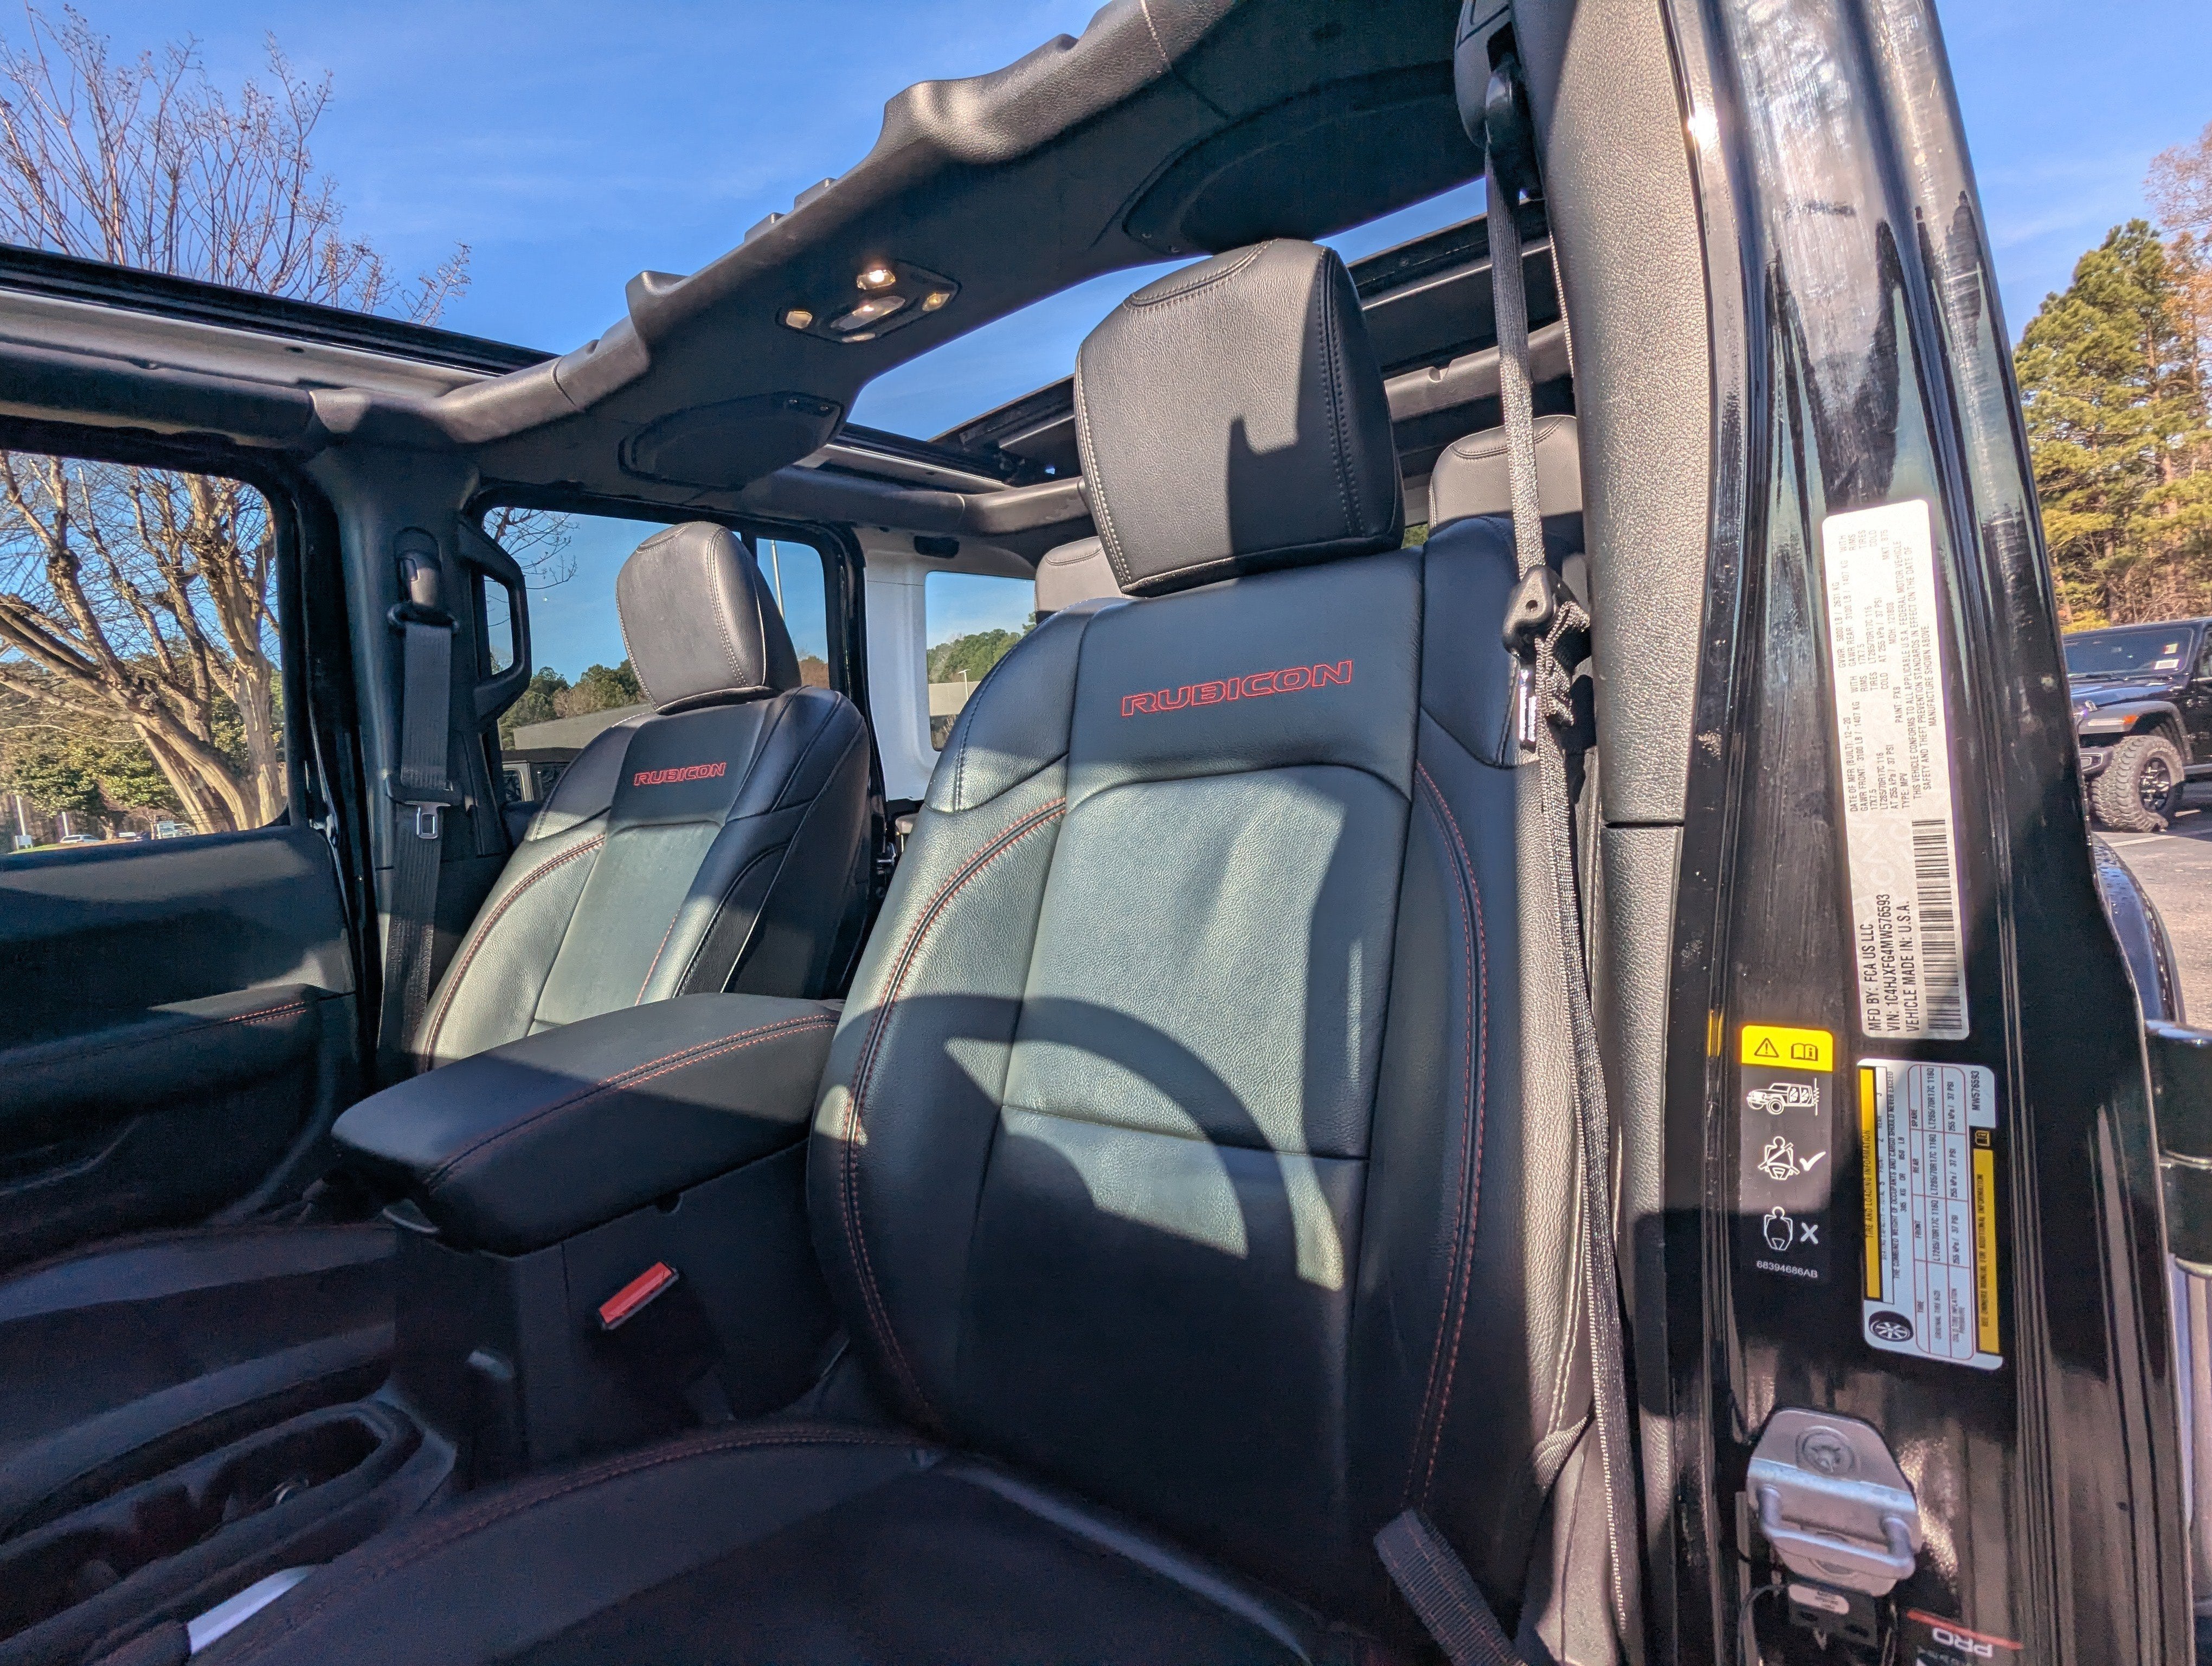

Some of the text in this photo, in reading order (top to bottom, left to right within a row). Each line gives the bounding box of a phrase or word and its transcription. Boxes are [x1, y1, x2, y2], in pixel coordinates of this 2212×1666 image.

[1838, 534, 1847, 552] WITH
[1868, 529, 1877, 547] COLD
[1893, 540, 1903, 567] VEHICLE
[1904, 546, 1913, 554] OF
[1840, 559, 1848, 568] KG
[1905, 556, 1914, 574] DATE
[1831, 581, 1840, 591] KG
[1841, 571, 1849, 585] 1407
[1895, 569, 1905, 593] MOTOR
[1906, 576, 1915, 589] THE
[1832, 593, 1841, 607] 2631
[1843, 594, 1851, 603] LB
[1848, 533, 1866, 665] 17X7.5 RIMS
[1857, 529, 1876, 664] LT285/70R17C 116 TIRES
[1874, 597, 1882, 607] PSI
[1907, 591, 1917, 601] ON
[1844, 605, 1853, 620] 3100
[1875, 609, 1883, 618] 37
[1898, 595, 1907, 625] FEDERAL
[1908, 604, 1918, 627] EFFECT
[1834, 616, 1842, 625] LB
[1835, 626, 1844, 642] 5800
[1876, 626, 1885, 638] kPa
[1888, 626, 1897, 644] MDH:
[1877, 640, 1886, 652] 255
[1837, 645, 1846, 668] GVWR:
[1847, 646, 1856, 667] GAWR
[1879, 654, 1887, 663] AT
[1911, 639, 1922, 680] STANDARDS
[1922, 649, 1933, 674] SHOWN
[1902, 650, 1913, 690] APPLICABLE
[1121, 659, 1353, 717] RUBICON
[1849, 675, 1859, 693] WITH
[1880, 671, 1888, 689] COLD
[1851, 701, 1860, 710] KG
[1905, 691, 1914, 704] ALL
[1914, 681, 1926, 723] PREVENTION
[1925, 676, 1937, 726] MANUFACTURE
[1853, 712, 1861, 726] 1407
[1893, 701, 1903, 723] PAINT:
[1906, 706, 1914, 714] TO
[1859, 675, 1877, 810] 17X7.5 RIMS
[1869, 671, 1888, 810] LT285/70R17C 116 TIRES
[1907, 716, 1918, 753] CONFORMS
[1918, 726, 1927, 746] THEFT
[1844, 740, 1856, 766] (BUILT):
[1855, 746, 1864, 761] 3100
[1886, 744, 1894, 754] PSI
[1920, 748, 1929, 762] AND
[633, 761, 727, 786] RUBICON
[1847, 768, 1856, 782] MFR
[1856, 765, 1866, 789] FRONT:
[1909, 755, 1920, 782] VEHICLE
[1921, 765, 1931, 790] SAFETY
[1888, 773, 1896, 785] kPa
[1899, 772, 1908, 787] MPV
[1848, 784, 1856, 793] OF
[1889, 786, 1898, 798] 255
[1912, 784, 1921, 799] THIS
[1849, 794, 1858, 812] DATE
[1859, 791, 1868, 811] GAWR
[1890, 800, 1899, 809] AT
[1900, 789, 1910, 809] TYPE:
[1876, 894, 1900, 1031] VIN: 1C4HJXFG4MW576593
[1895, 901, 1920, 1032] VEHICLE MADE IN: U.S.A.
[1860, 924, 1881, 1031] MFD BY: FCA US LLC
[1970, 1070, 1980, 1110] MW576593
[1862, 1130, 1873, 1238] TIRE AND LOADING INFORMATION
[1756, 1260, 1818, 1279] 68394686AB
[1932, 1627, 1993, 1658] PRO
